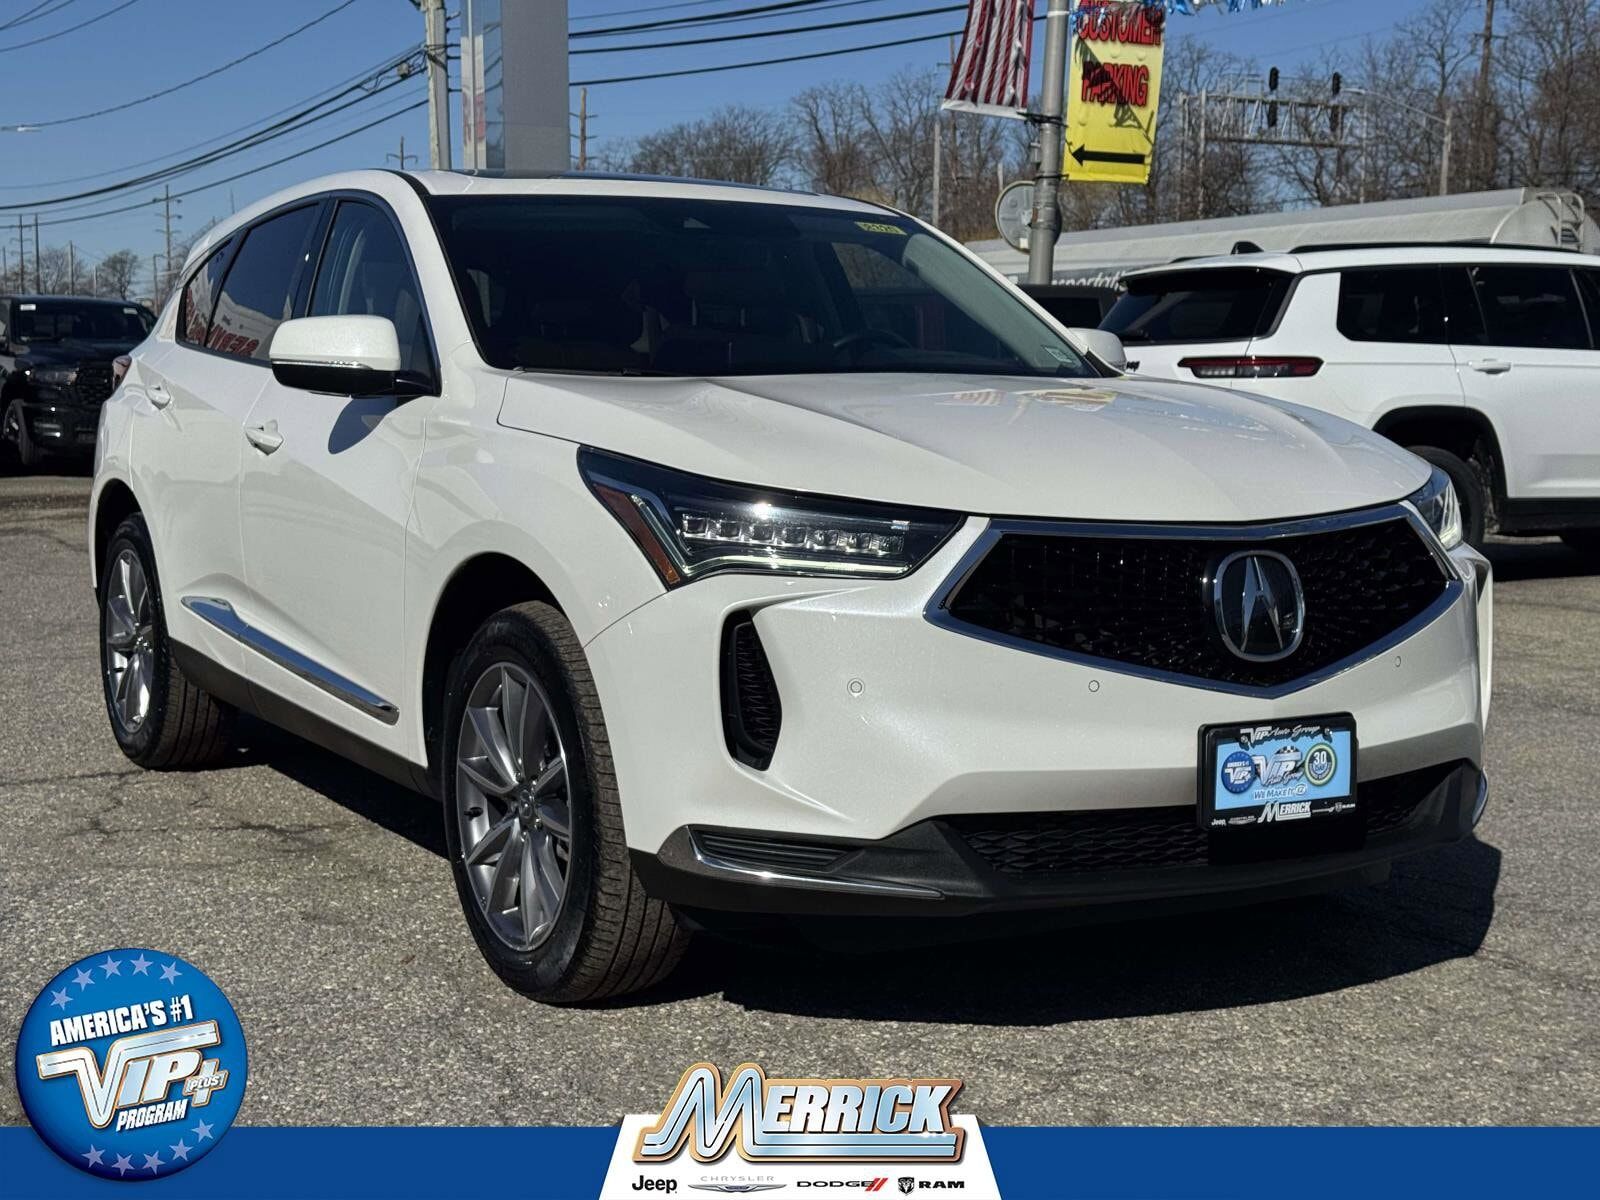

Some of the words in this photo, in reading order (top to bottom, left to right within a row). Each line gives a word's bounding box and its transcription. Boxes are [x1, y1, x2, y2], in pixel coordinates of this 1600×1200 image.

[1082, 61, 1150, 107] PARKING
[1313, 750, 1327, 765] 30
[1257, 801, 1312, 823] MERRICK
